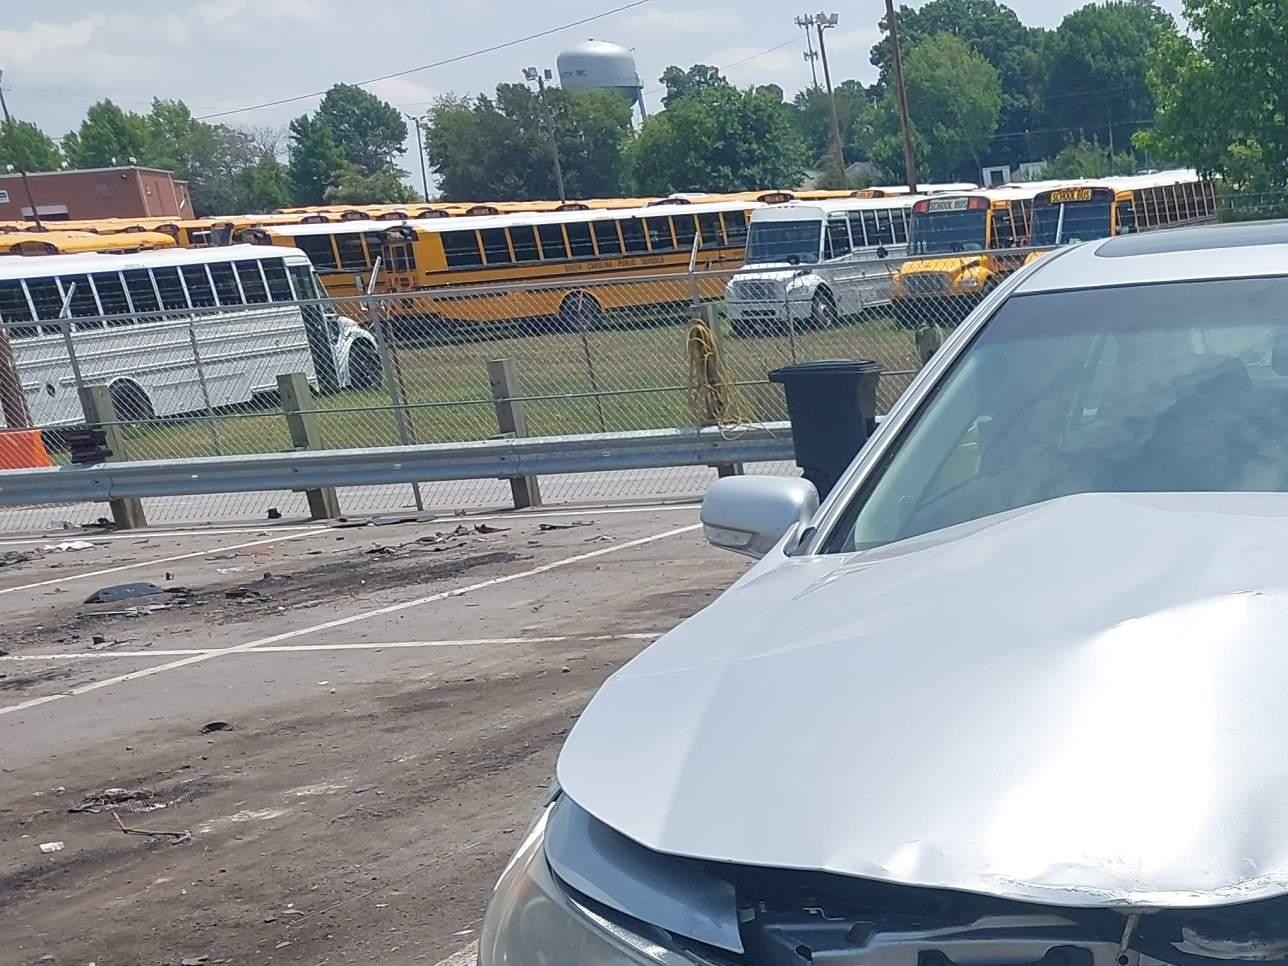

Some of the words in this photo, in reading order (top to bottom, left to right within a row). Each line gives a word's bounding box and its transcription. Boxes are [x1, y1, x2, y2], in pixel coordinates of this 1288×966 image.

[1052, 191, 1075, 202] SCHOOL
[1077, 189, 1091, 200] BUS
[930, 201, 953, 211] SCHOOL
[954, 199, 968, 209] BUS
